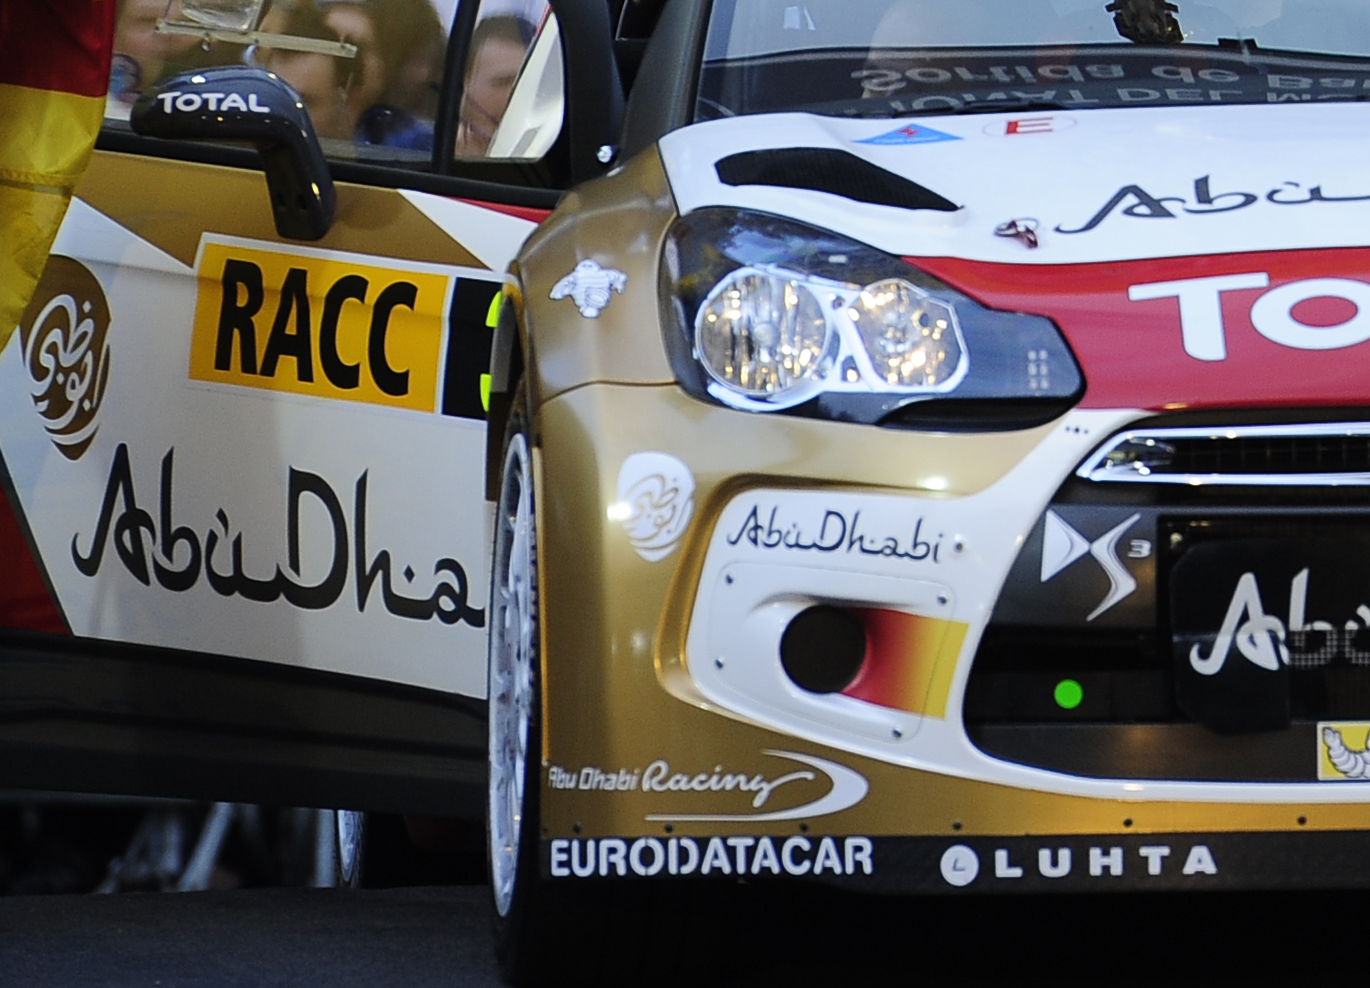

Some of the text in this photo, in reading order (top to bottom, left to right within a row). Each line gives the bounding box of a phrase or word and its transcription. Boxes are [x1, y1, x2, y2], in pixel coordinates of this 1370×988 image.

[157, 90, 271, 114] TOTAL
[215, 258, 419, 397] RACC
[283, 465, 485, 629] Dha
[548, 760, 816, 809] Abu Dhabi Racing
[550, 835, 874, 878] EURODATACAR
[994, 844, 1218, 879] LUHTA
